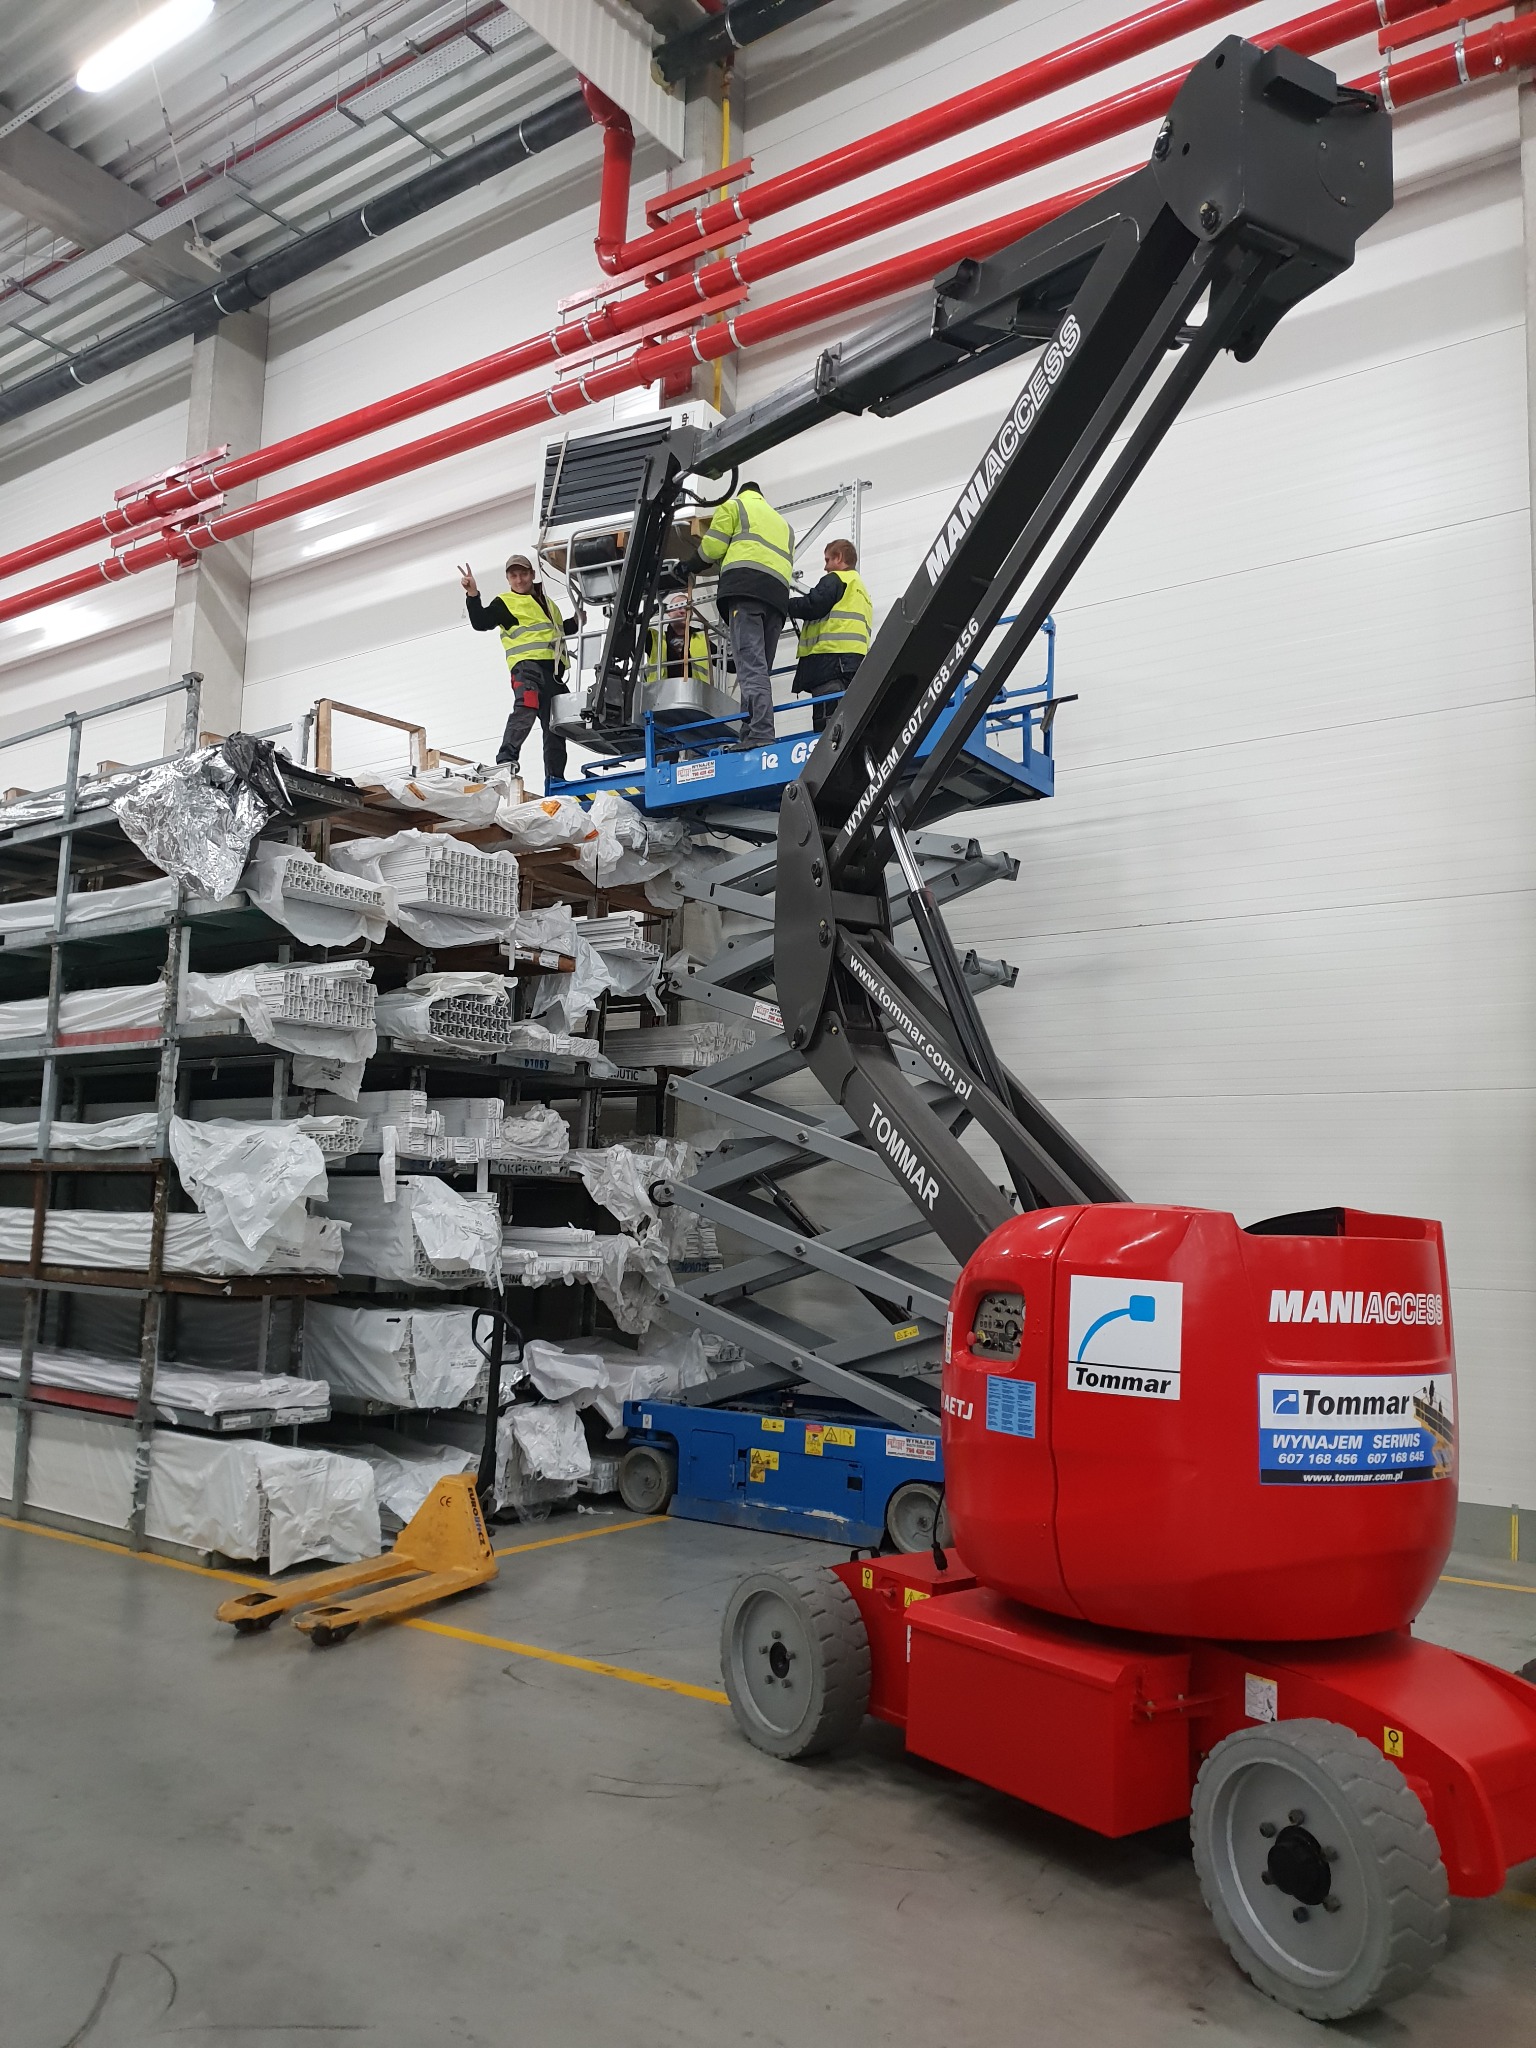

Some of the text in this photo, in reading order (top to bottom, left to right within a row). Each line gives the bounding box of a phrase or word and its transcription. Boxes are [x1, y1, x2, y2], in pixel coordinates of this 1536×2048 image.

[925, 314, 1081, 586] MANIACCESS
[844, 747, 900, 837] WYNAJEM
[850, 955, 973, 1101] www.tommar.com.pl
[869, 1102, 940, 1211] TOMMAR
[1268, 1289, 1443, 1325] MANIACCESS
[1075, 1367, 1171, 1394] Tommar
[1303, 1389, 1410, 1416] Tommar
[1272, 1433, 1421, 1450] WYNAJEM SERWIS
[1278, 1450, 1425, 1464] 607 168 456 607 168 645
[1303, 1471, 1403, 1482] www.tommar.com.pl
